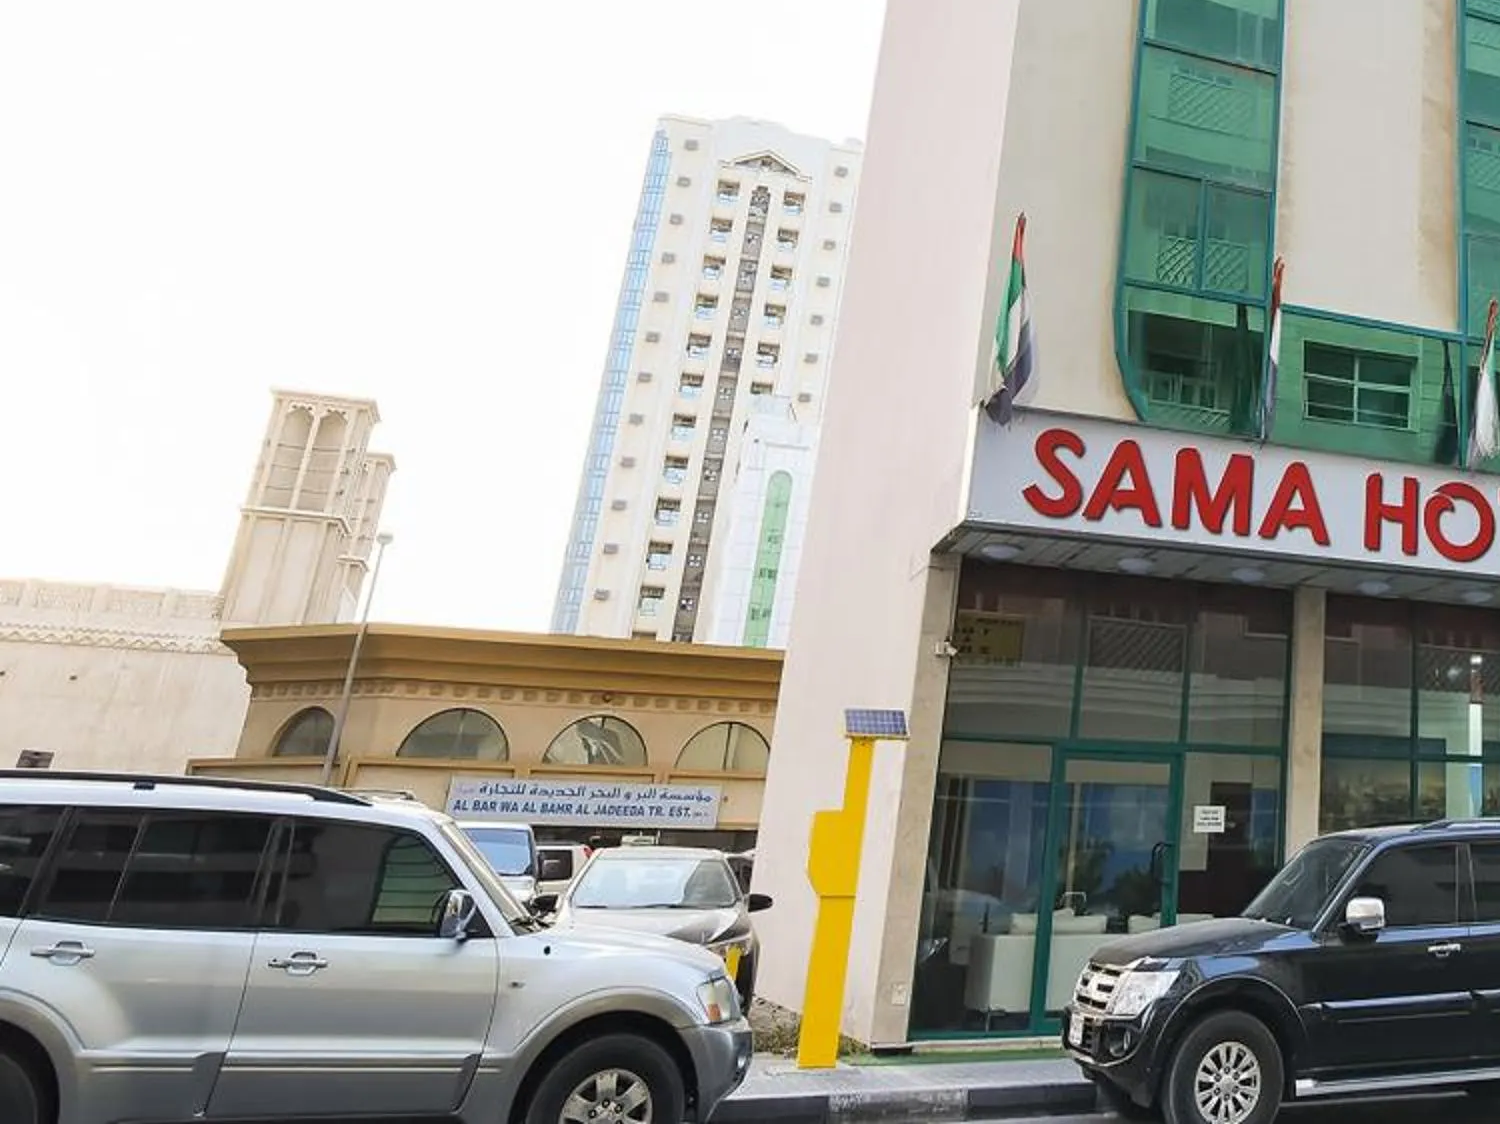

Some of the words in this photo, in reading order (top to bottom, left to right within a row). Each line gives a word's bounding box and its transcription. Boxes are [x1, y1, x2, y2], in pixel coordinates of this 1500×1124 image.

[1022, 429, 1330, 546] SAMA
[454, 800, 468, 811] AL
[472, 800, 497, 812] BAR
[500, 801, 519, 813] WA
[522, 802, 537, 813] AL
[576, 804, 589, 815] AL
[594, 804, 645, 816] JADEEDA
